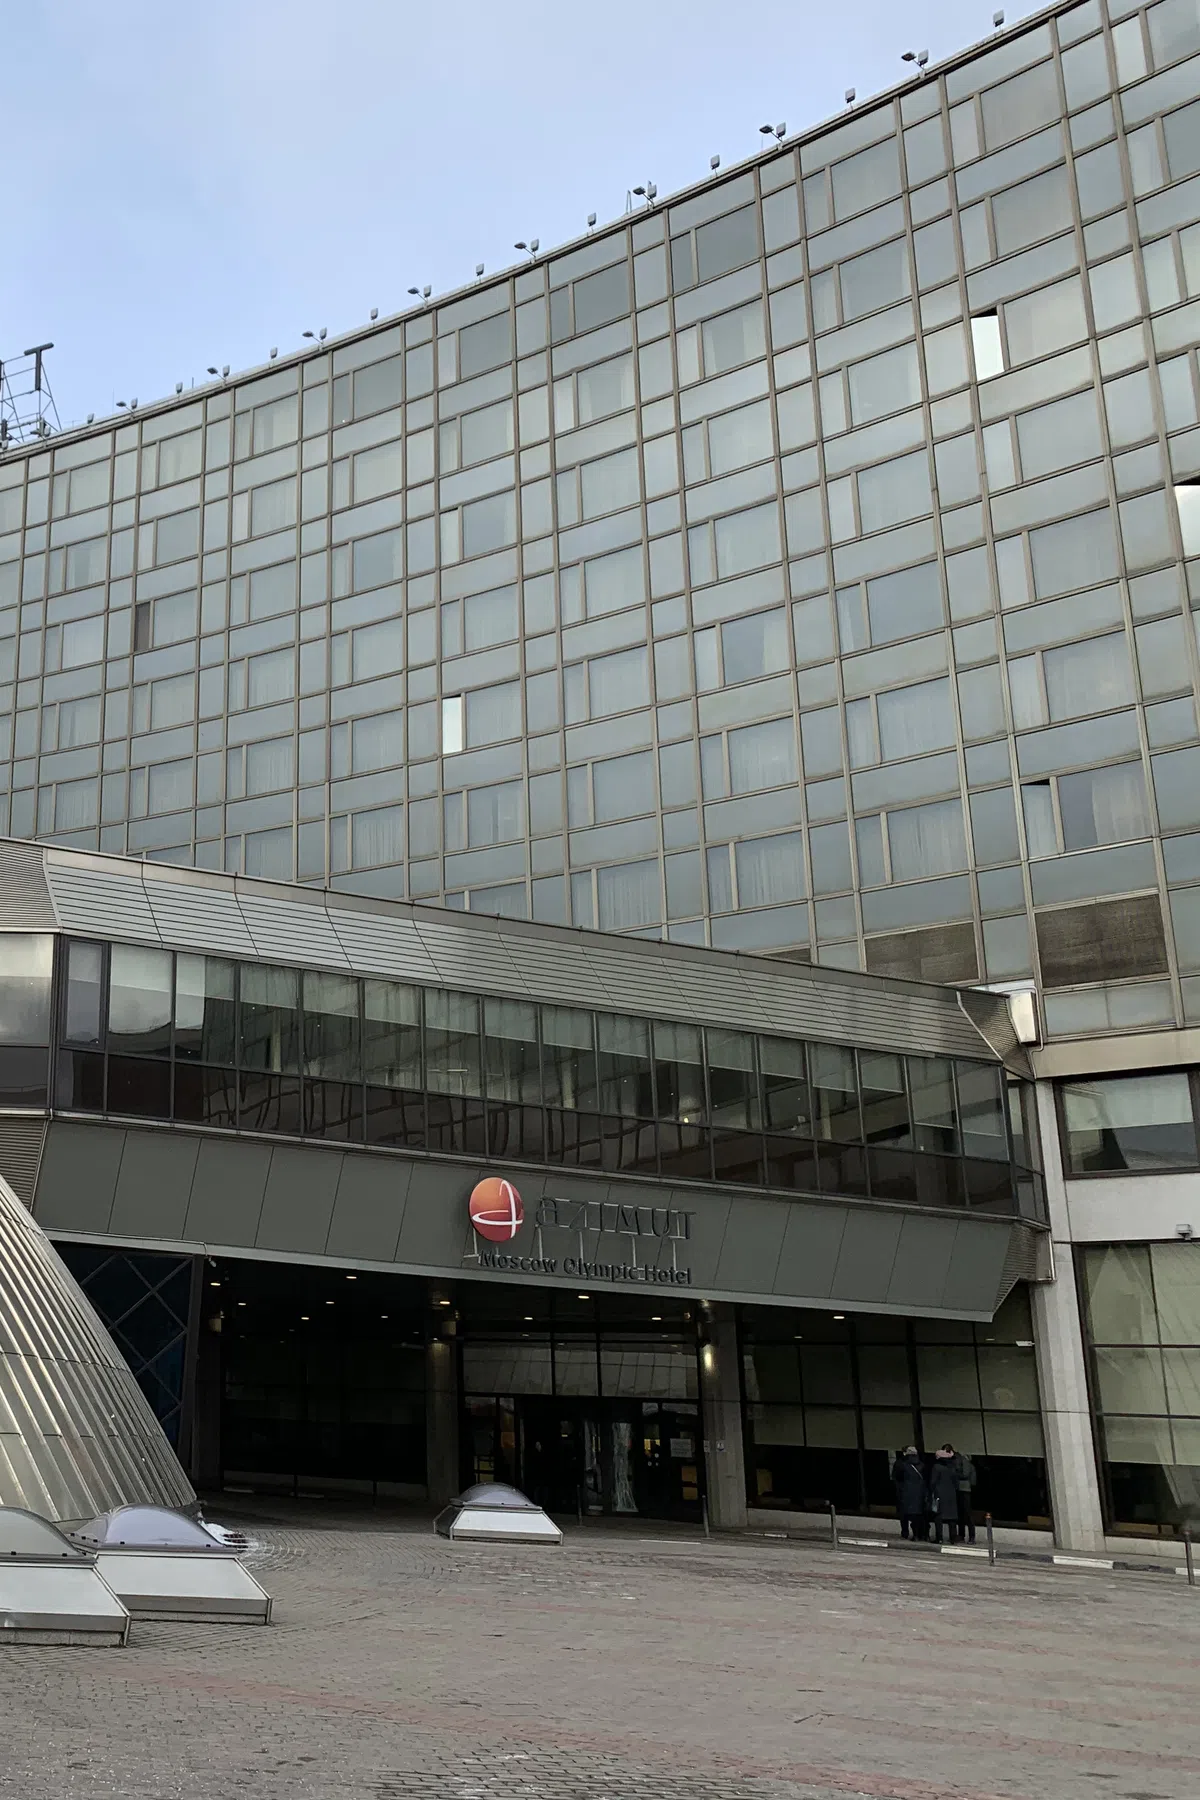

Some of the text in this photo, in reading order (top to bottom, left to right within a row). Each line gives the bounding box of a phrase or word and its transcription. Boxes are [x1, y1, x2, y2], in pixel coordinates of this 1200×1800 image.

[479, 1249, 691, 1284] Moscow Olympic Hotel
